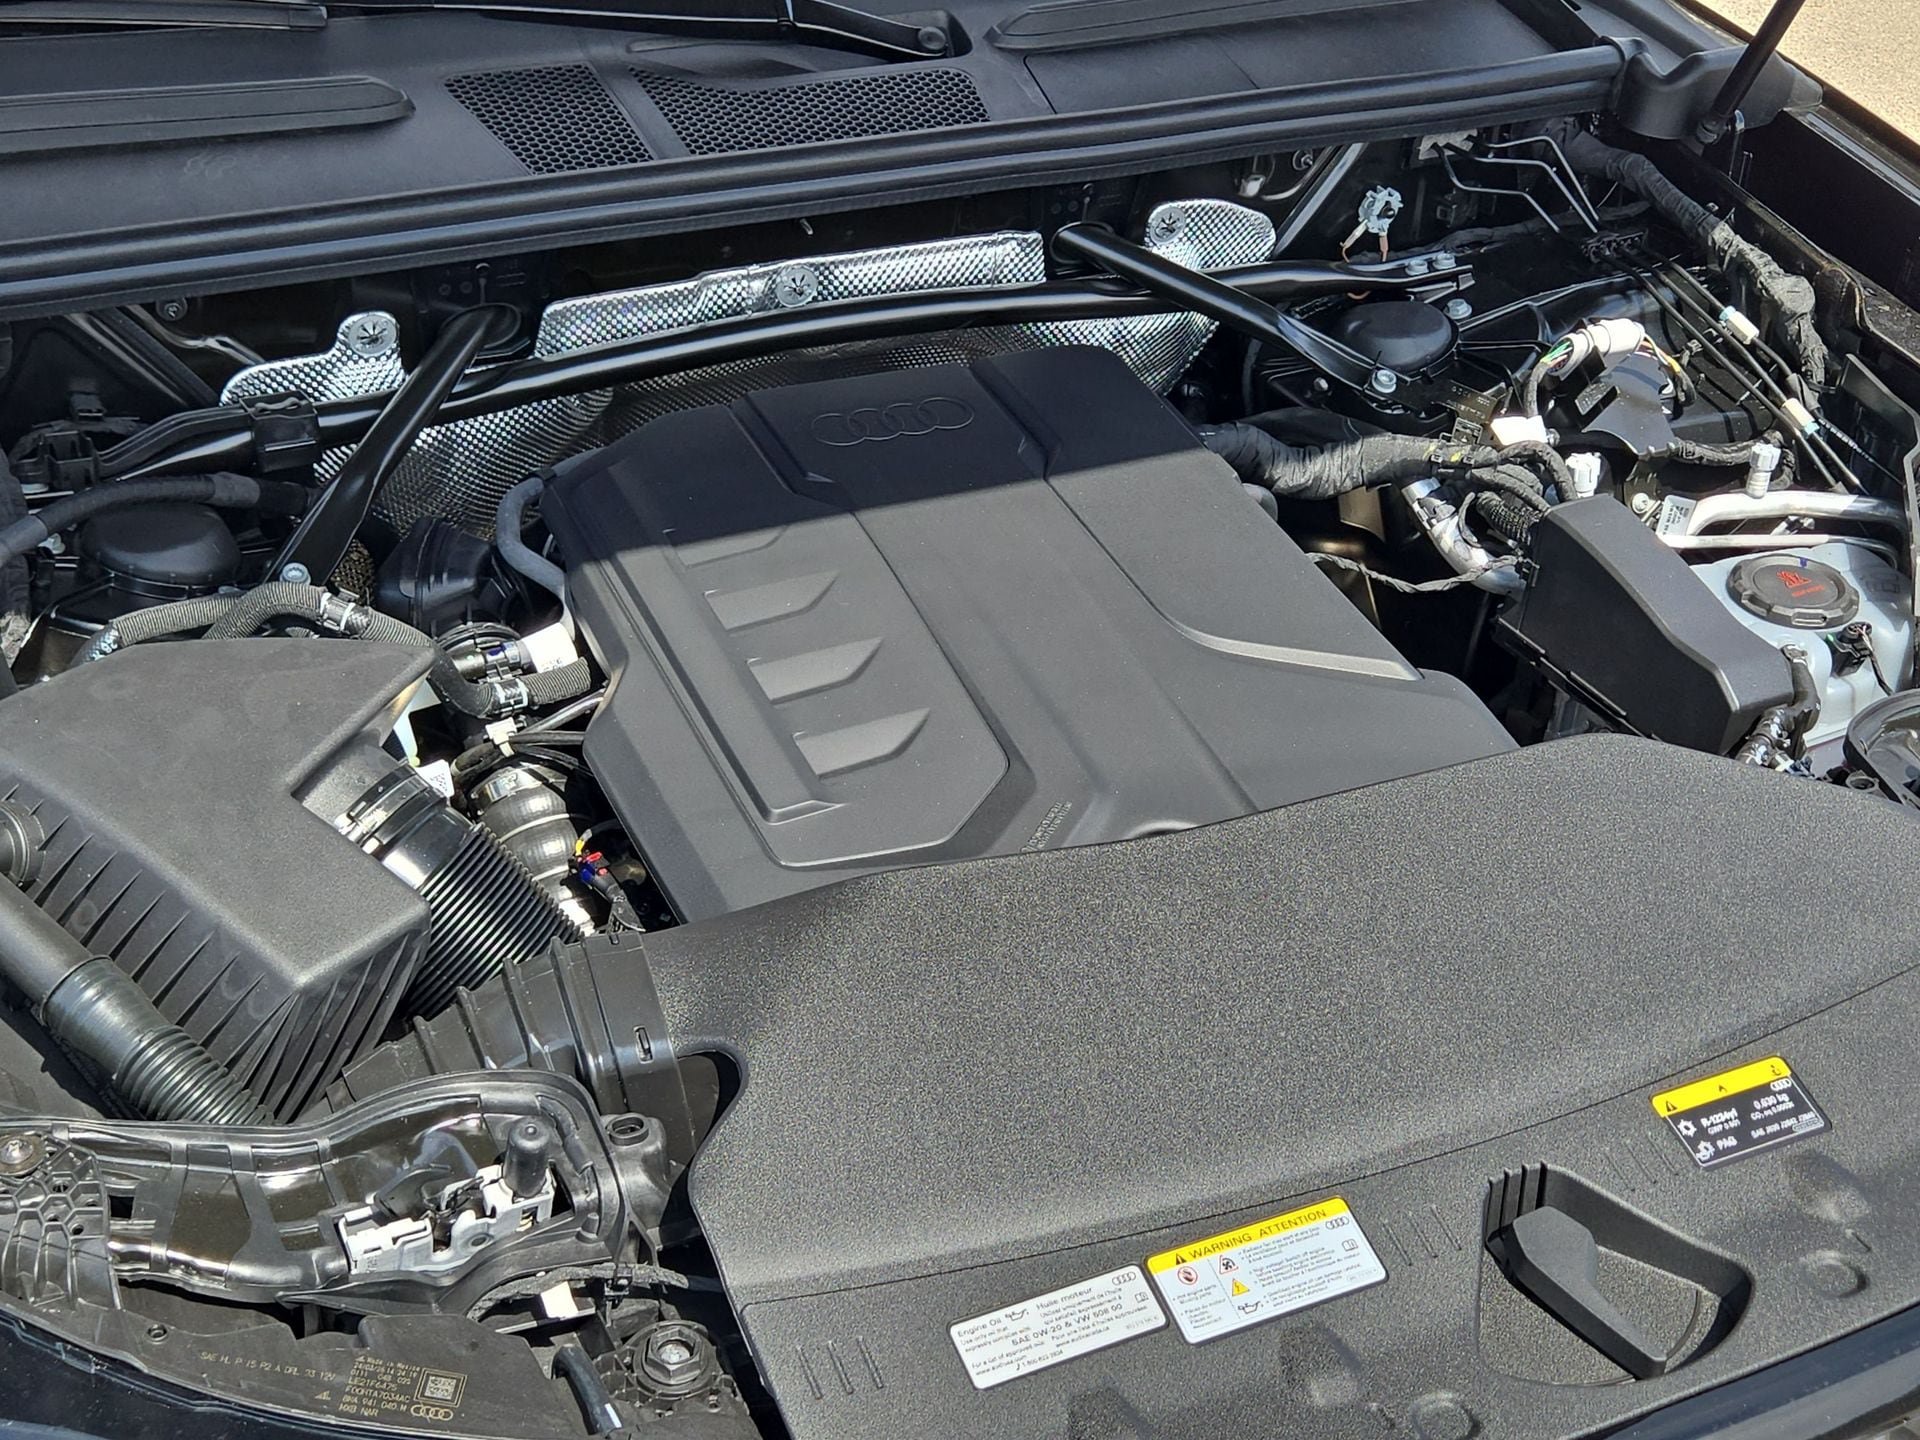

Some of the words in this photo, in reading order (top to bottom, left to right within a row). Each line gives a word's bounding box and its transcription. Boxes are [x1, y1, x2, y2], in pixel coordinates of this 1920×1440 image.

[1259, 1209, 1326, 1237] ATTENTION
[1188, 1232, 1252, 1258] WARNING
[1035, 1299, 1058, 1310] Huile
[1060, 1287, 1091, 1302] moteur
[957, 1323, 987, 1337] Engine
[988, 1317, 1002, 1326] Oil
[1011, 1334, 1031, 1346] SAE
[1073, 1313, 1090, 1324] VW
